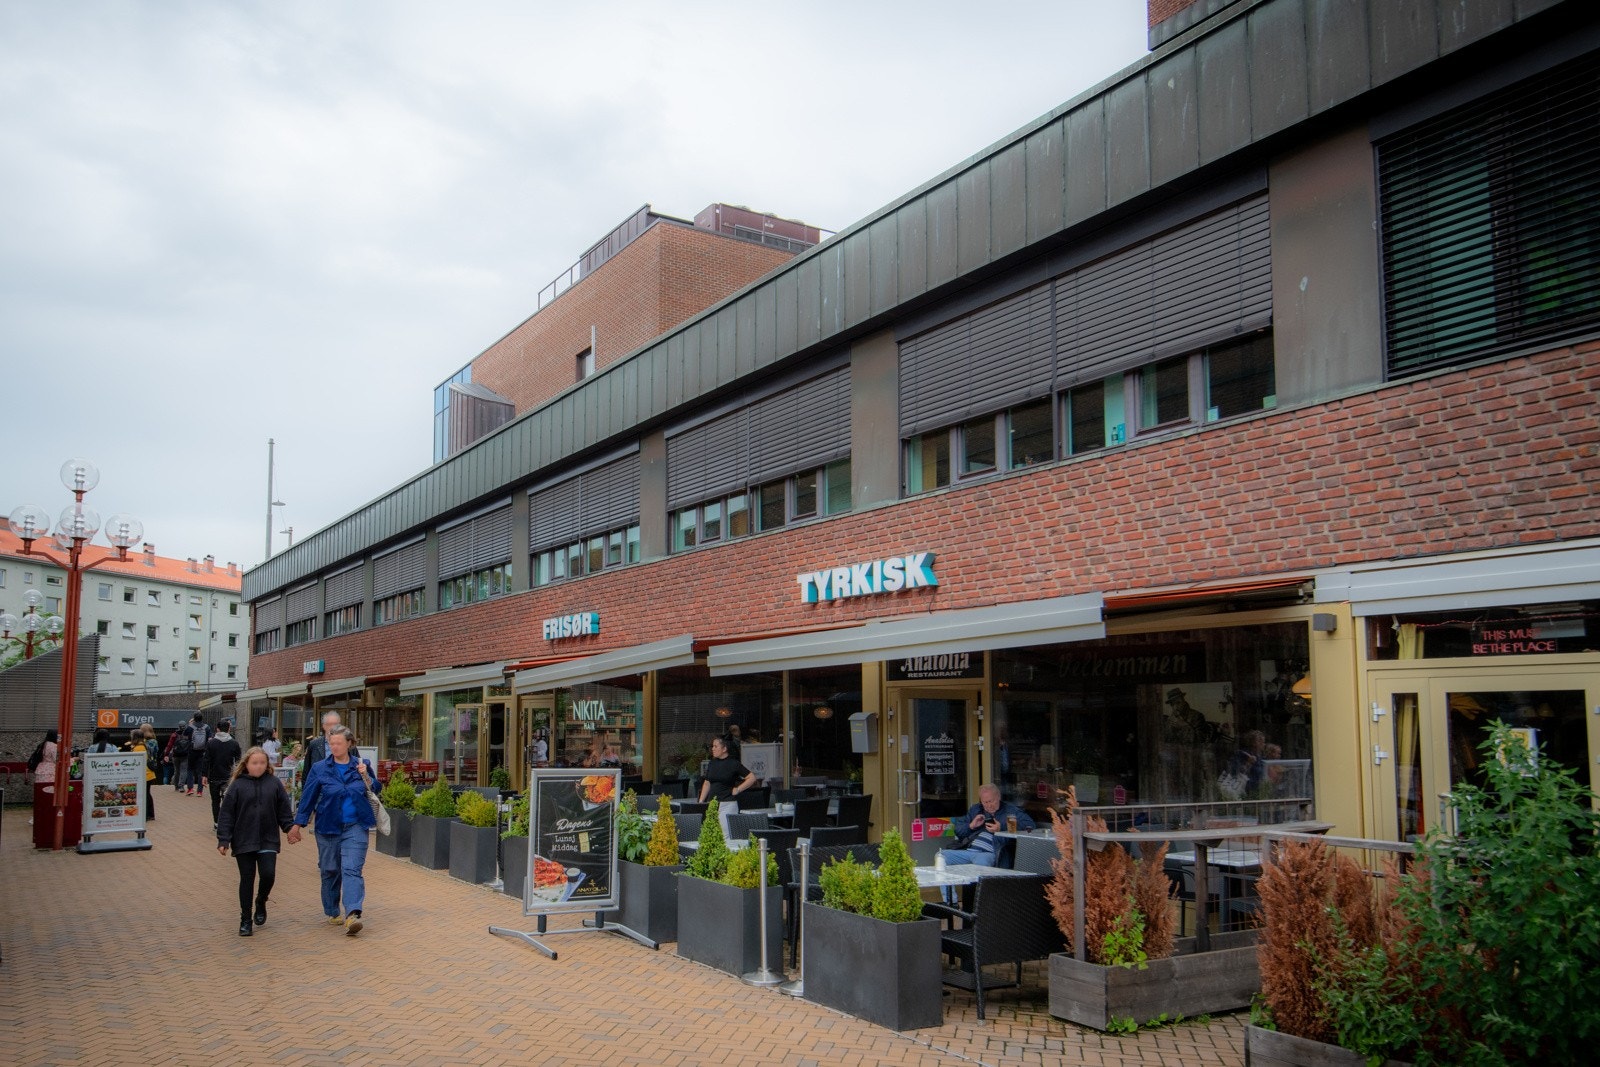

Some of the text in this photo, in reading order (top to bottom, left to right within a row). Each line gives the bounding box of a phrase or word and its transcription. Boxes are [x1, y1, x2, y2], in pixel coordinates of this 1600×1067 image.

[796, 552, 933, 603] TYRKISK
[542, 612, 595, 640] FRISØR
[1481, 630, 1506, 640] THIS
[1472, 640, 1556, 654] BE THE PLACE
[572, 699, 607, 720] NIKITA
[121, 713, 155, 725] Tøyen
[556, 818, 594, 833] Dagens
[928, 823, 942, 831] JUST
[554, 835, 576, 844] Lunsj
[551, 843, 578, 852] Middag
